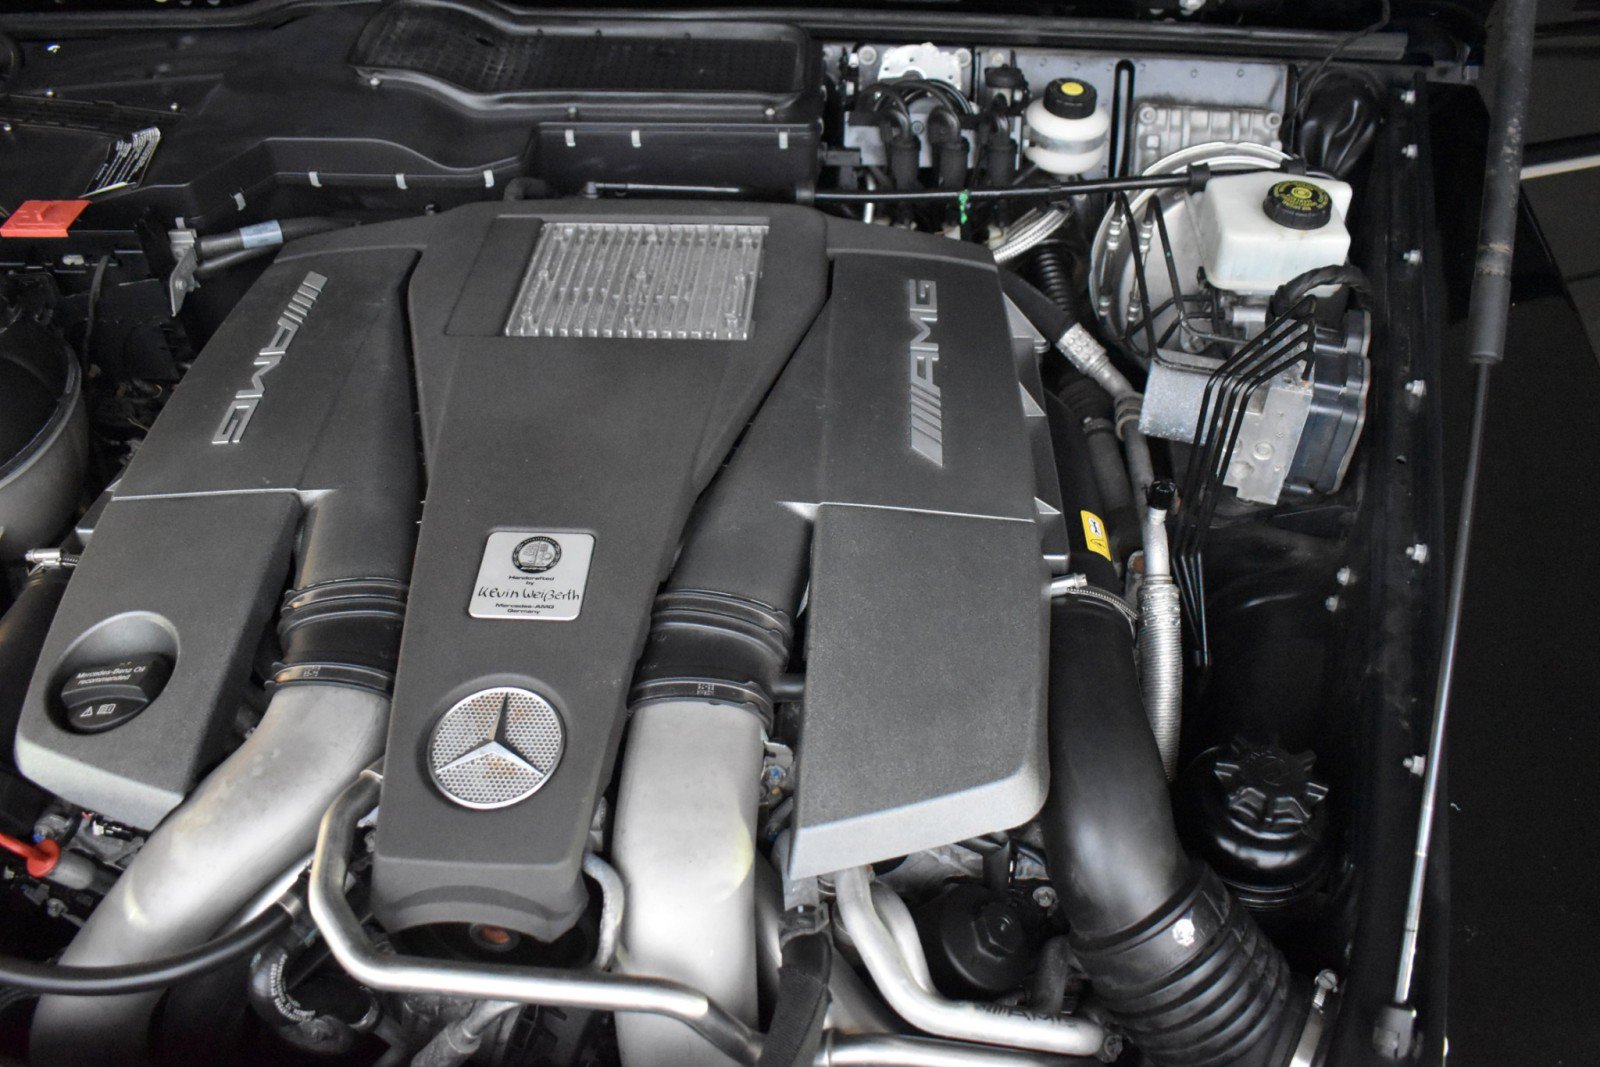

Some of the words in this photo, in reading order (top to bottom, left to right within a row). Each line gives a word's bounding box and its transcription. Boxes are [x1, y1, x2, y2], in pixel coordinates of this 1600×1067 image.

[909, 279, 940, 387] AMG
[212, 316, 299, 445] AMG
[76, 668, 132, 679] Mercedes-Benz
[77, 675, 132, 685] recommended
